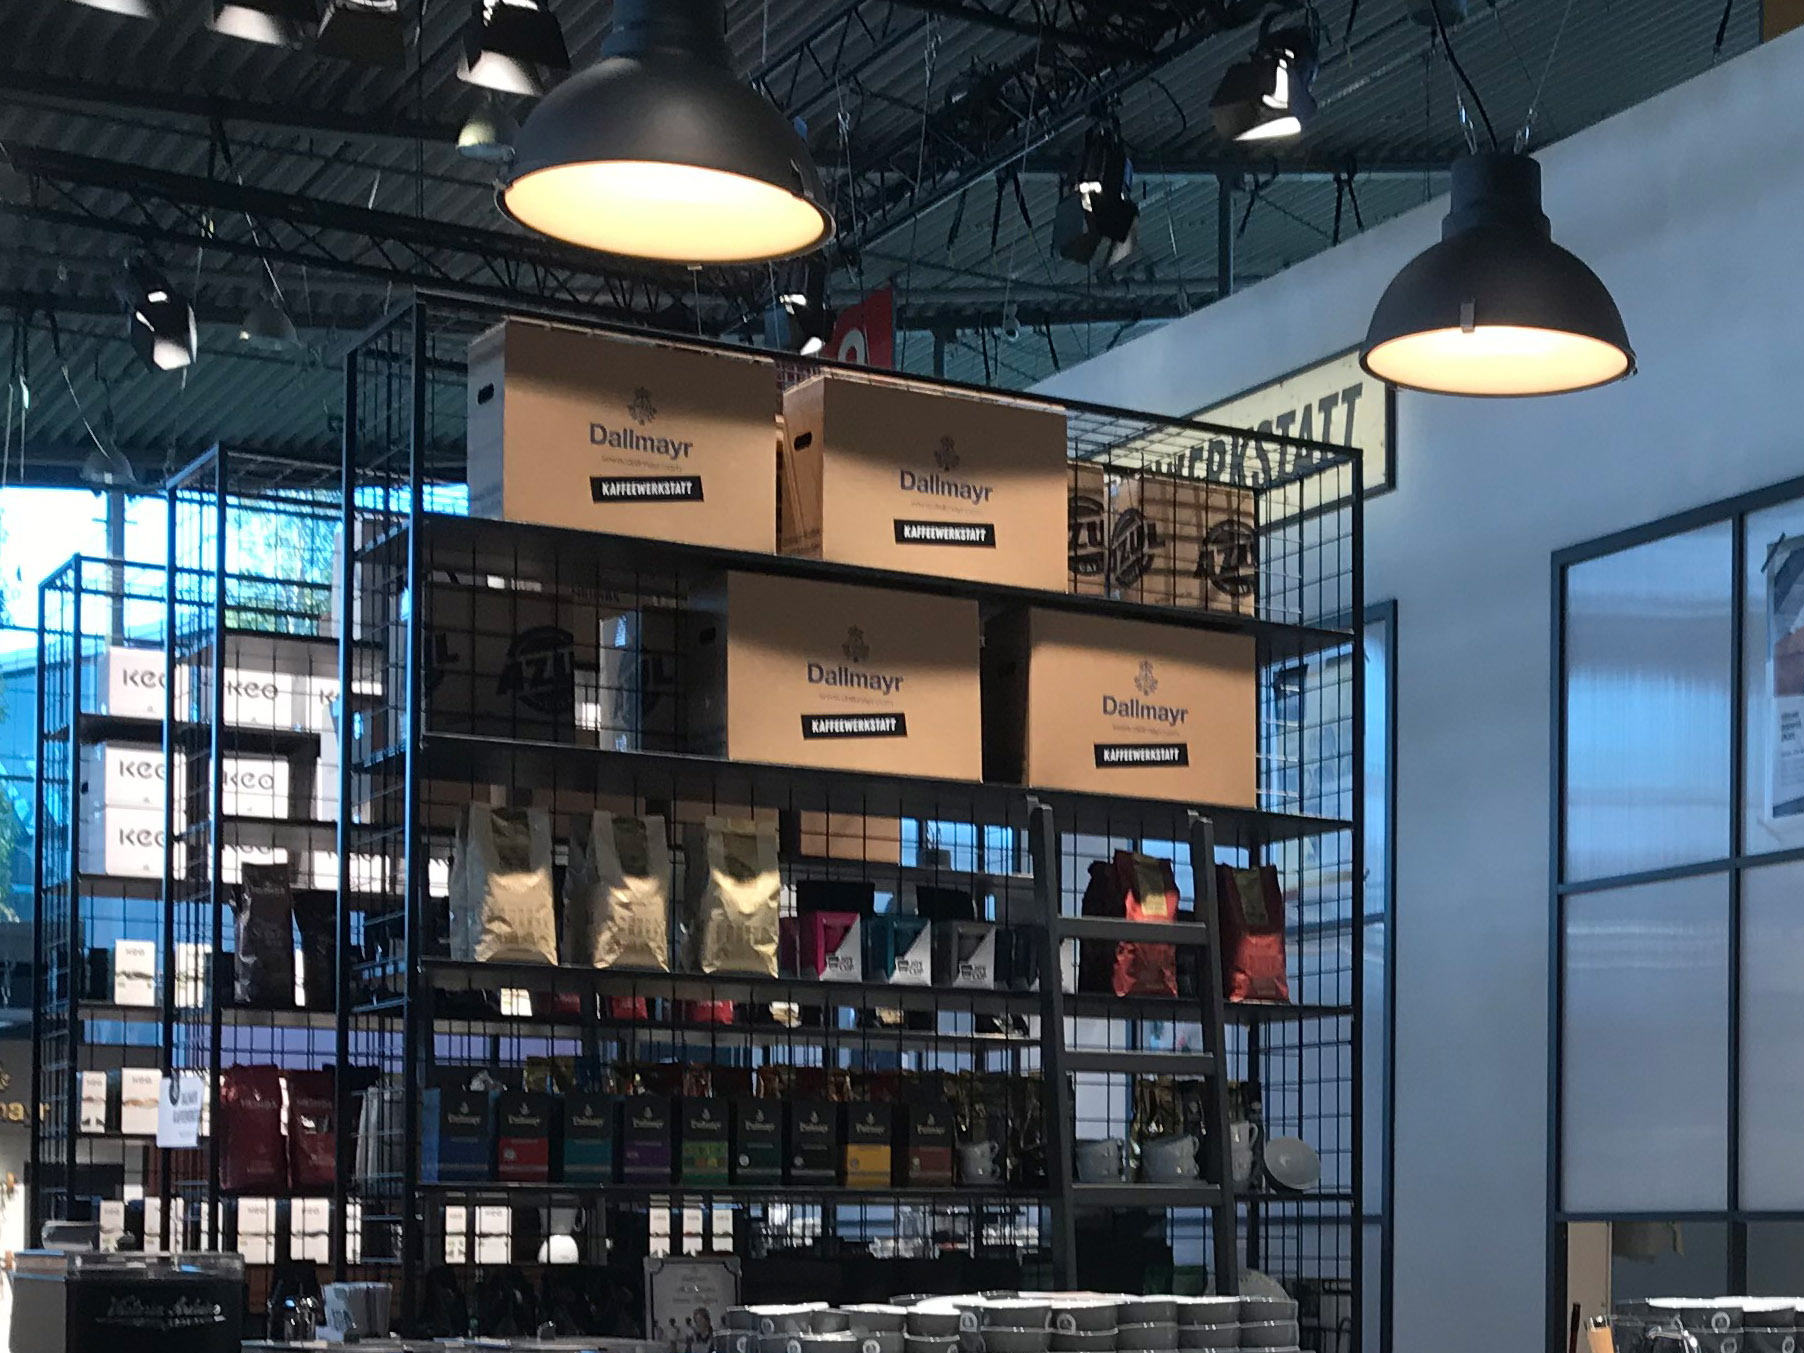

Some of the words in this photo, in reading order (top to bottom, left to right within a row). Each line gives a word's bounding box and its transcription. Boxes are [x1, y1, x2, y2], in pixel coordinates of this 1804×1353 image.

[589, 422, 693, 460] Dallmayr
[601, 480, 693, 496] KAFFEEWERKSTATT
[900, 469, 993, 505] Dallmayr
[903, 524, 987, 541] KAFFEEWERKSTATT
[807, 661, 904, 696] Dallmayr
[1102, 694, 1188, 727] Dallmayr
[811, 717, 897, 733] KAFFEEWERKSTATT
[1103, 747, 1180, 762] KAFFEEWERKSTATT
